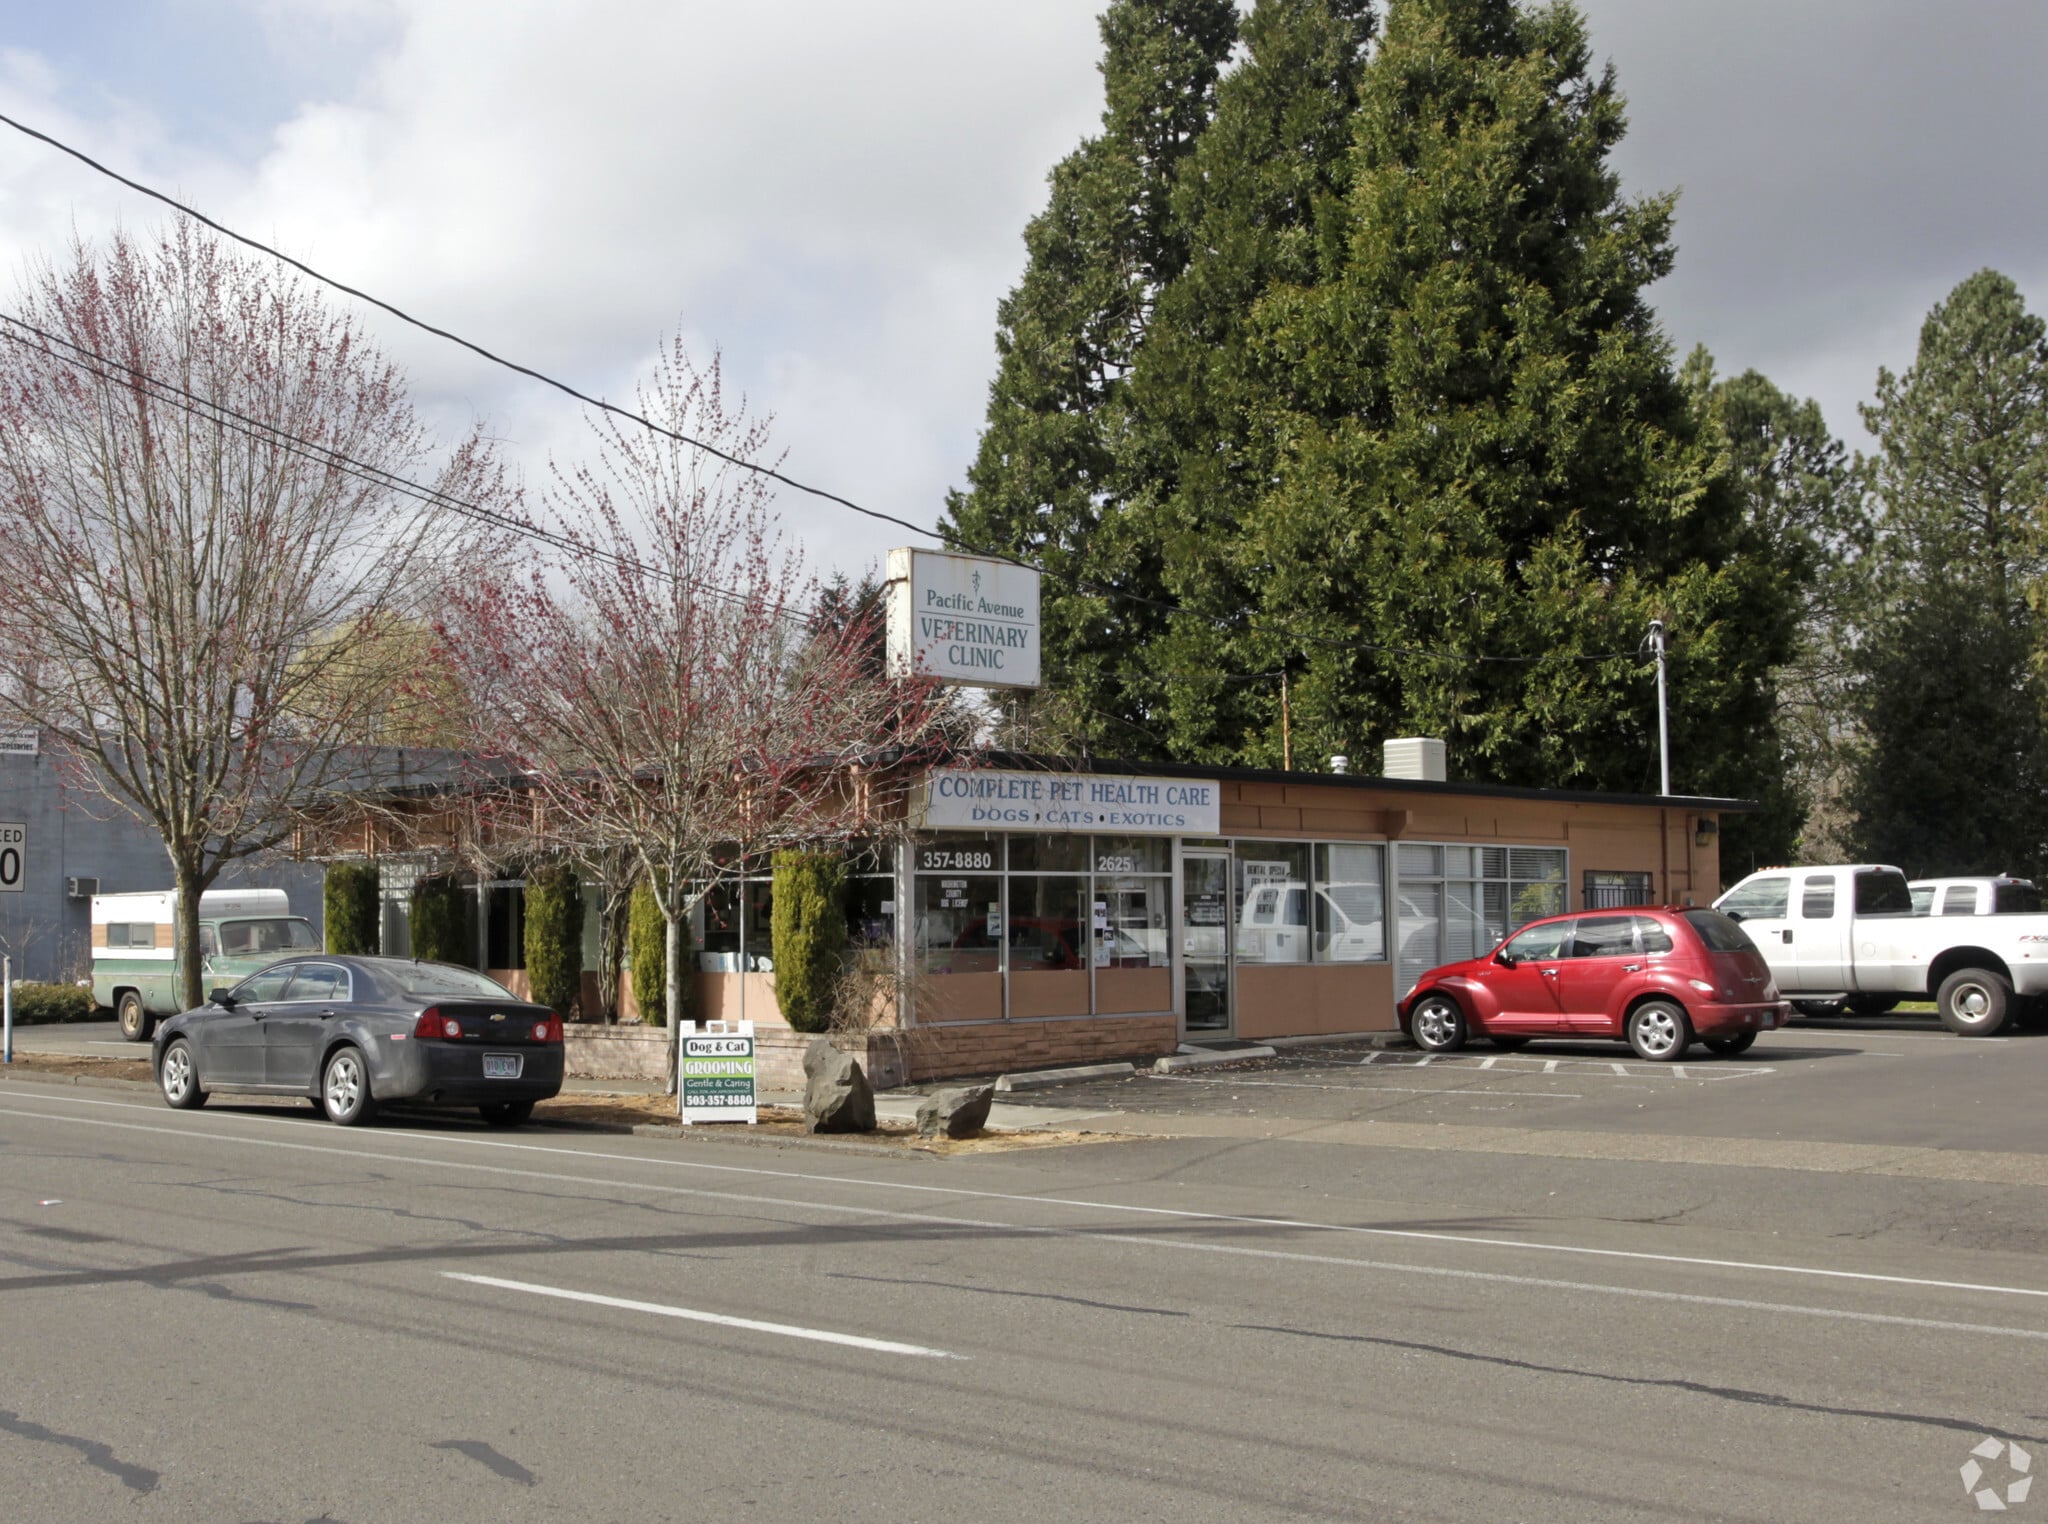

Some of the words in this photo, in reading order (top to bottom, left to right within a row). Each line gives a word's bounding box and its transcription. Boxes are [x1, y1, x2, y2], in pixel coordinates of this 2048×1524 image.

[927, 589, 974, 612] Pacific
[977, 597, 1024, 618] Avenue
[921, 617, 1028, 649] VETERINARY
[948, 645, 1004, 669] CLINIC
[939, 776, 1042, 801] COMPLETE
[1050, 782, 1083, 802] PET
[1091, 784, 1160, 805] HEALTH
[1166, 786, 1210, 806] CARE
[972, 808, 1029, 822] DOGS
[1046, 810, 1094, 824] CATS
[1110, 813, 1185, 826] EXOTICS
[0, 829, 22, 843] ED
[923, 851, 992, 869] 357-8880
[1098, 856, 1131, 872] 2625
[690, 1042, 712, 1054] Dog
[715, 1042, 723, 1052] &
[726, 1041, 745, 1052] Cat
[686, 1061, 752, 1075] GROOMING
[687, 1078, 713, 1088] Gentle
[715, 1080, 722, 1088] &
[724, 1079, 750, 1089] Caring
[686, 1095, 753, 1106] 503-357-8880
